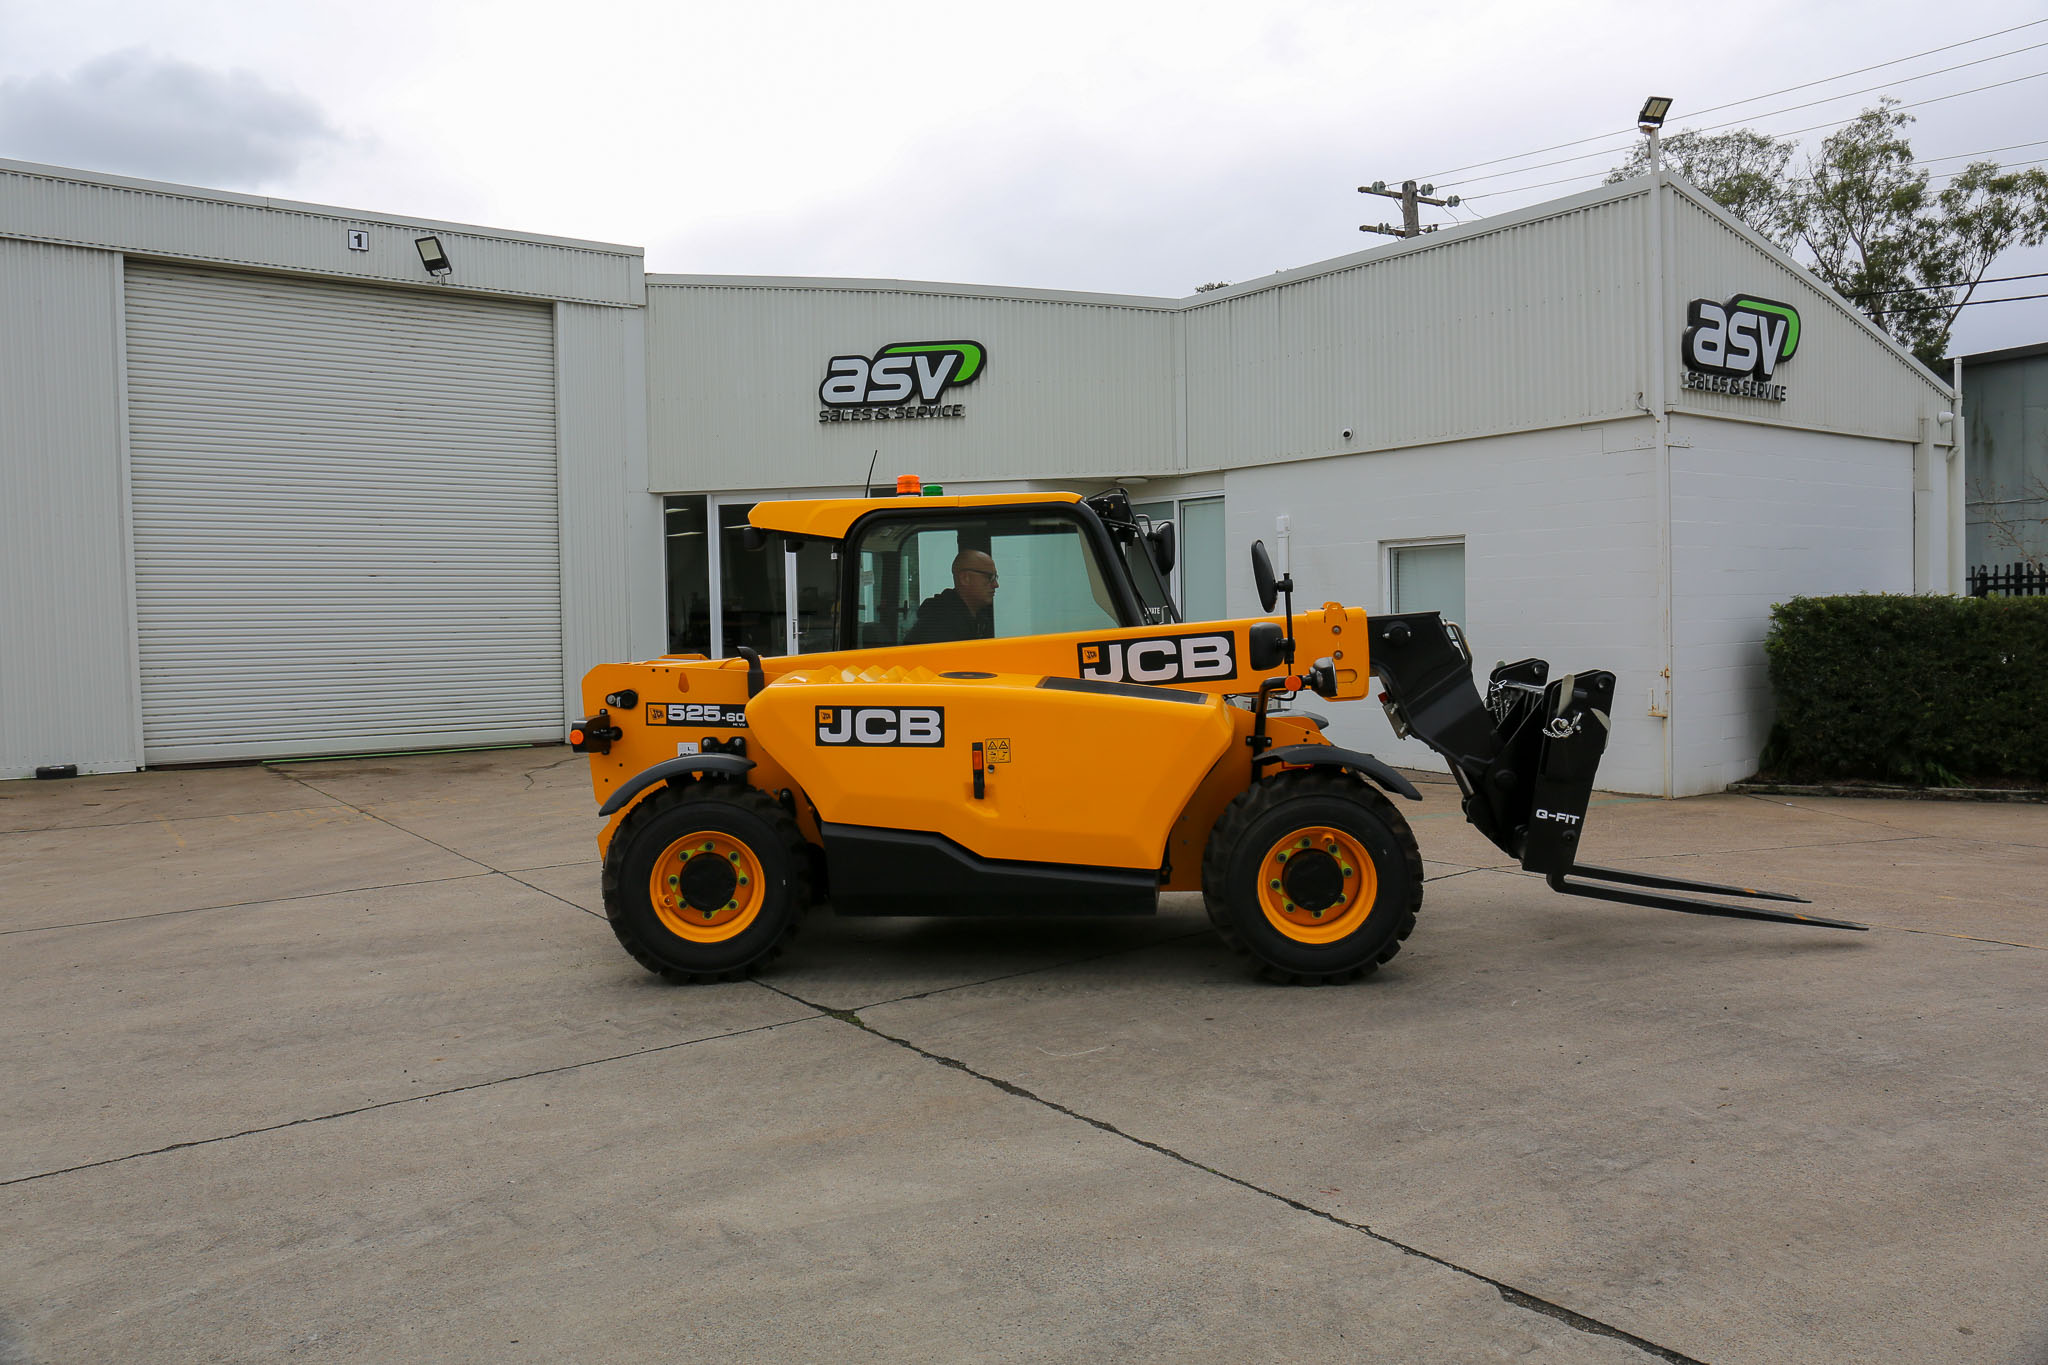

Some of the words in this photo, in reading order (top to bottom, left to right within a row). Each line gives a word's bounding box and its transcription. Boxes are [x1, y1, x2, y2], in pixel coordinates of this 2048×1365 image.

[353, 233, 362, 248] 1
[1729, 377, 1741, 395] &
[1742, 380, 1787, 402] SERVICE
[875, 407, 890, 420] &
[894, 404, 963, 419] SERVICE
[1083, 636, 1233, 683] JCB
[819, 709, 942, 744] JCB
[1536, 809, 1580, 825] Q-FIT
